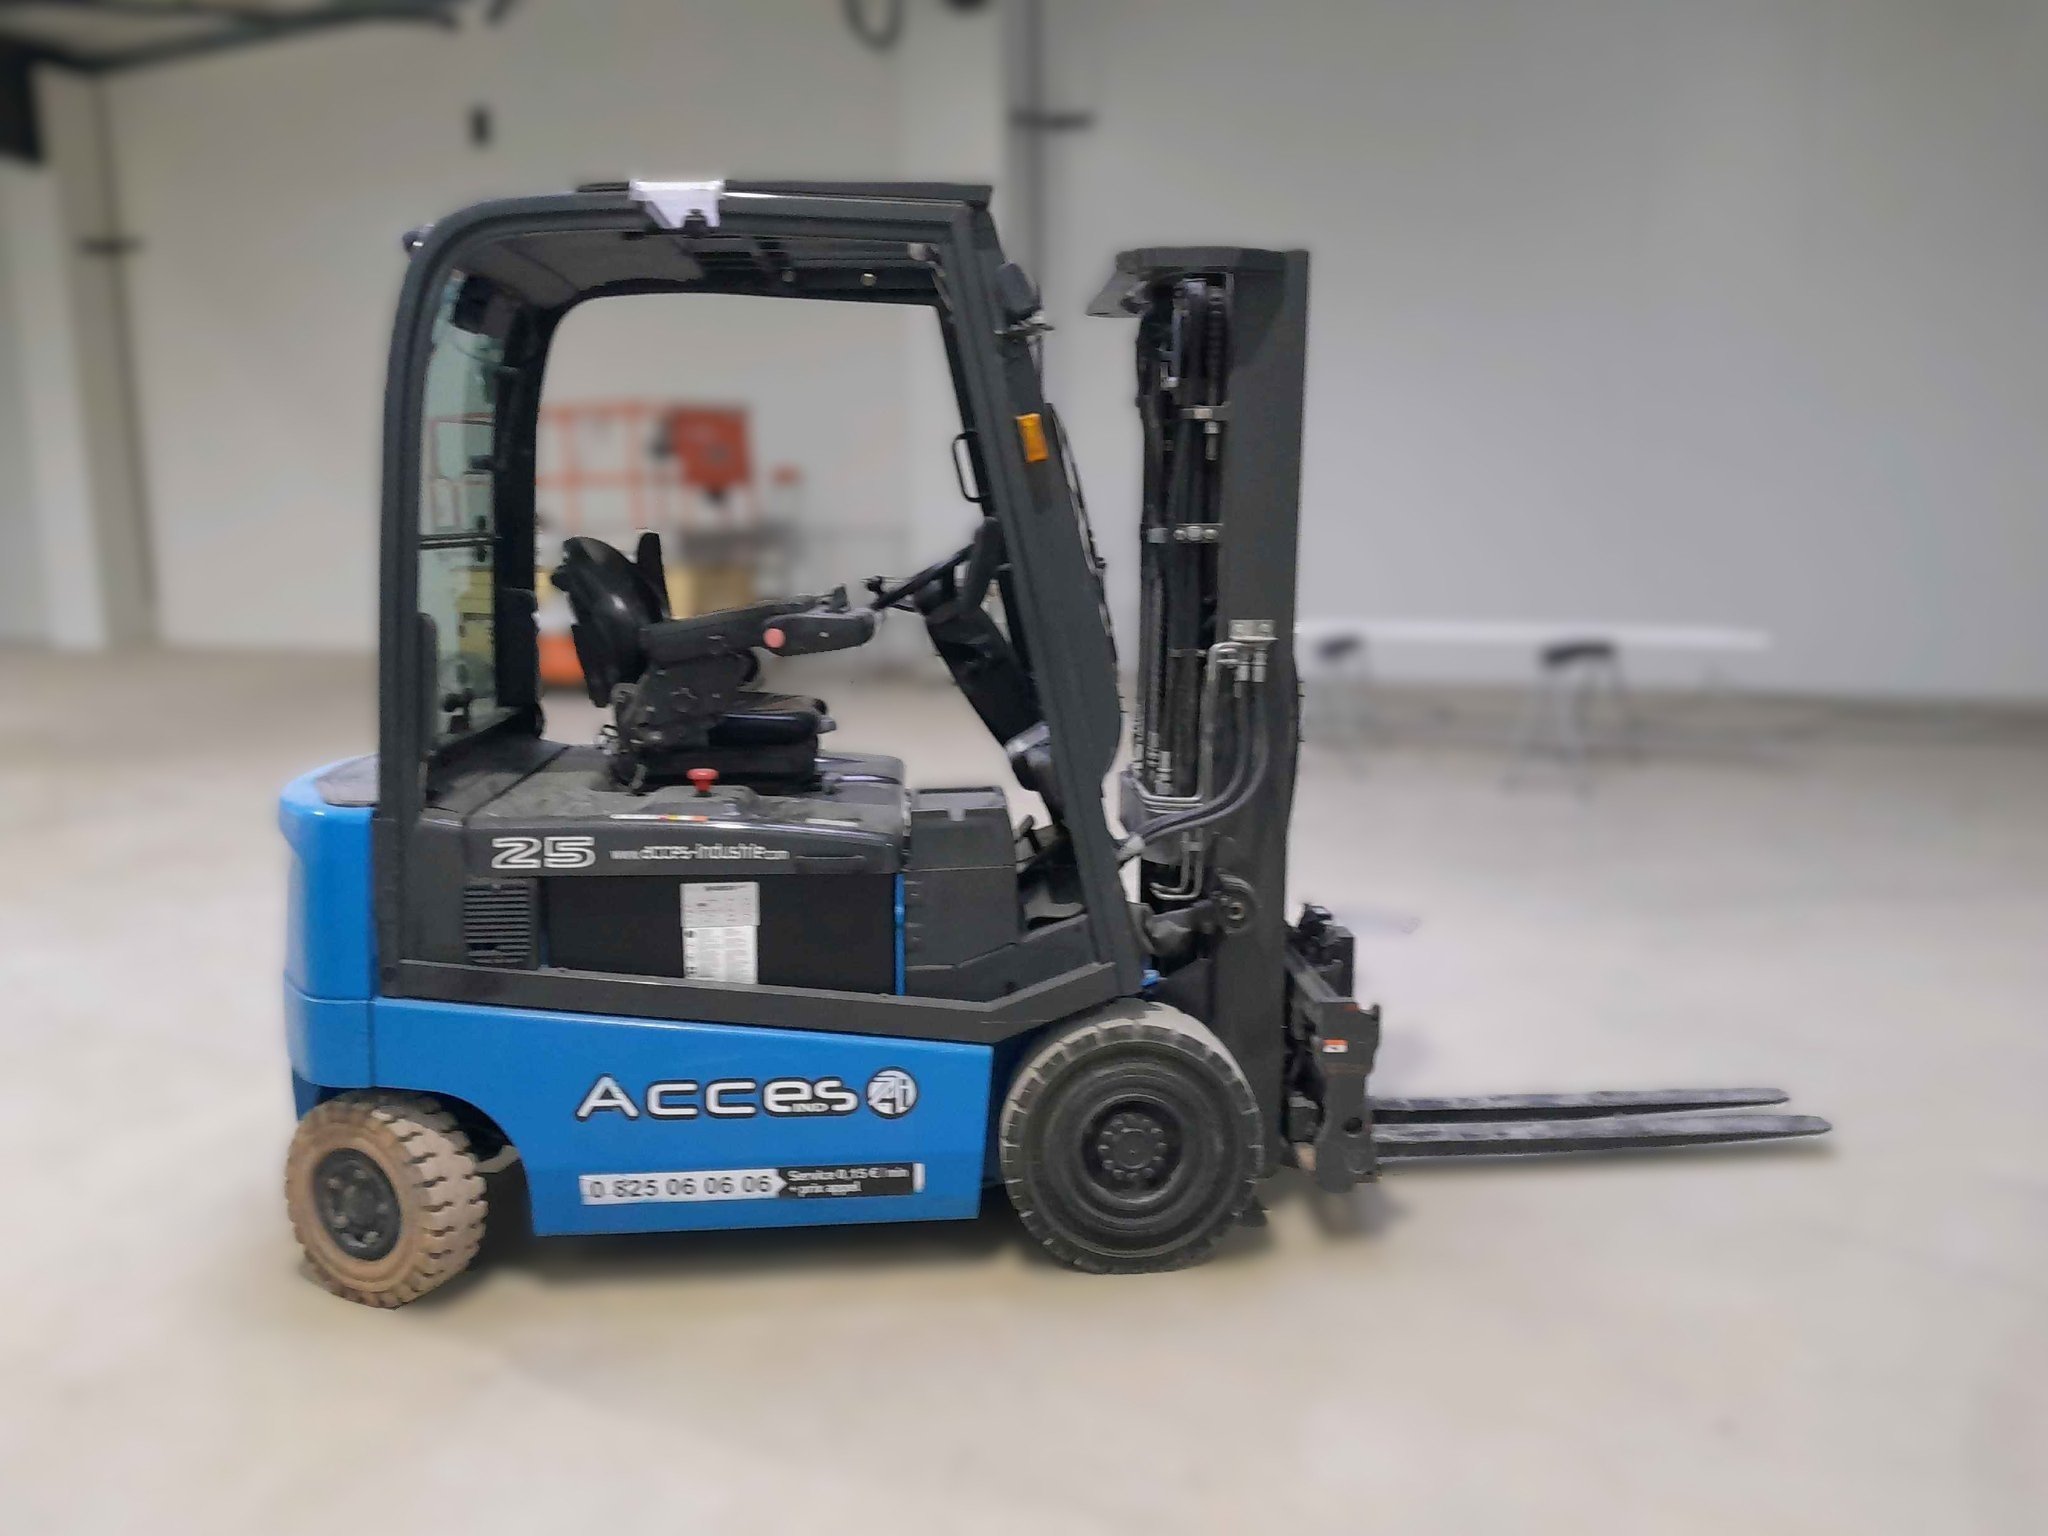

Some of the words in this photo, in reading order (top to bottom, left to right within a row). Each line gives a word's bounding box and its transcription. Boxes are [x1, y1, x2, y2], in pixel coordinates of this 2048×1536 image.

[491, 836, 596, 869] 25
[589, 1180, 606, 1198] 0
[612, 1179, 659, 1198] 825
[665, 1177, 697, 1196] 06
[703, 1176, 736, 1195] 06
[741, 1174, 772, 1193] 06
